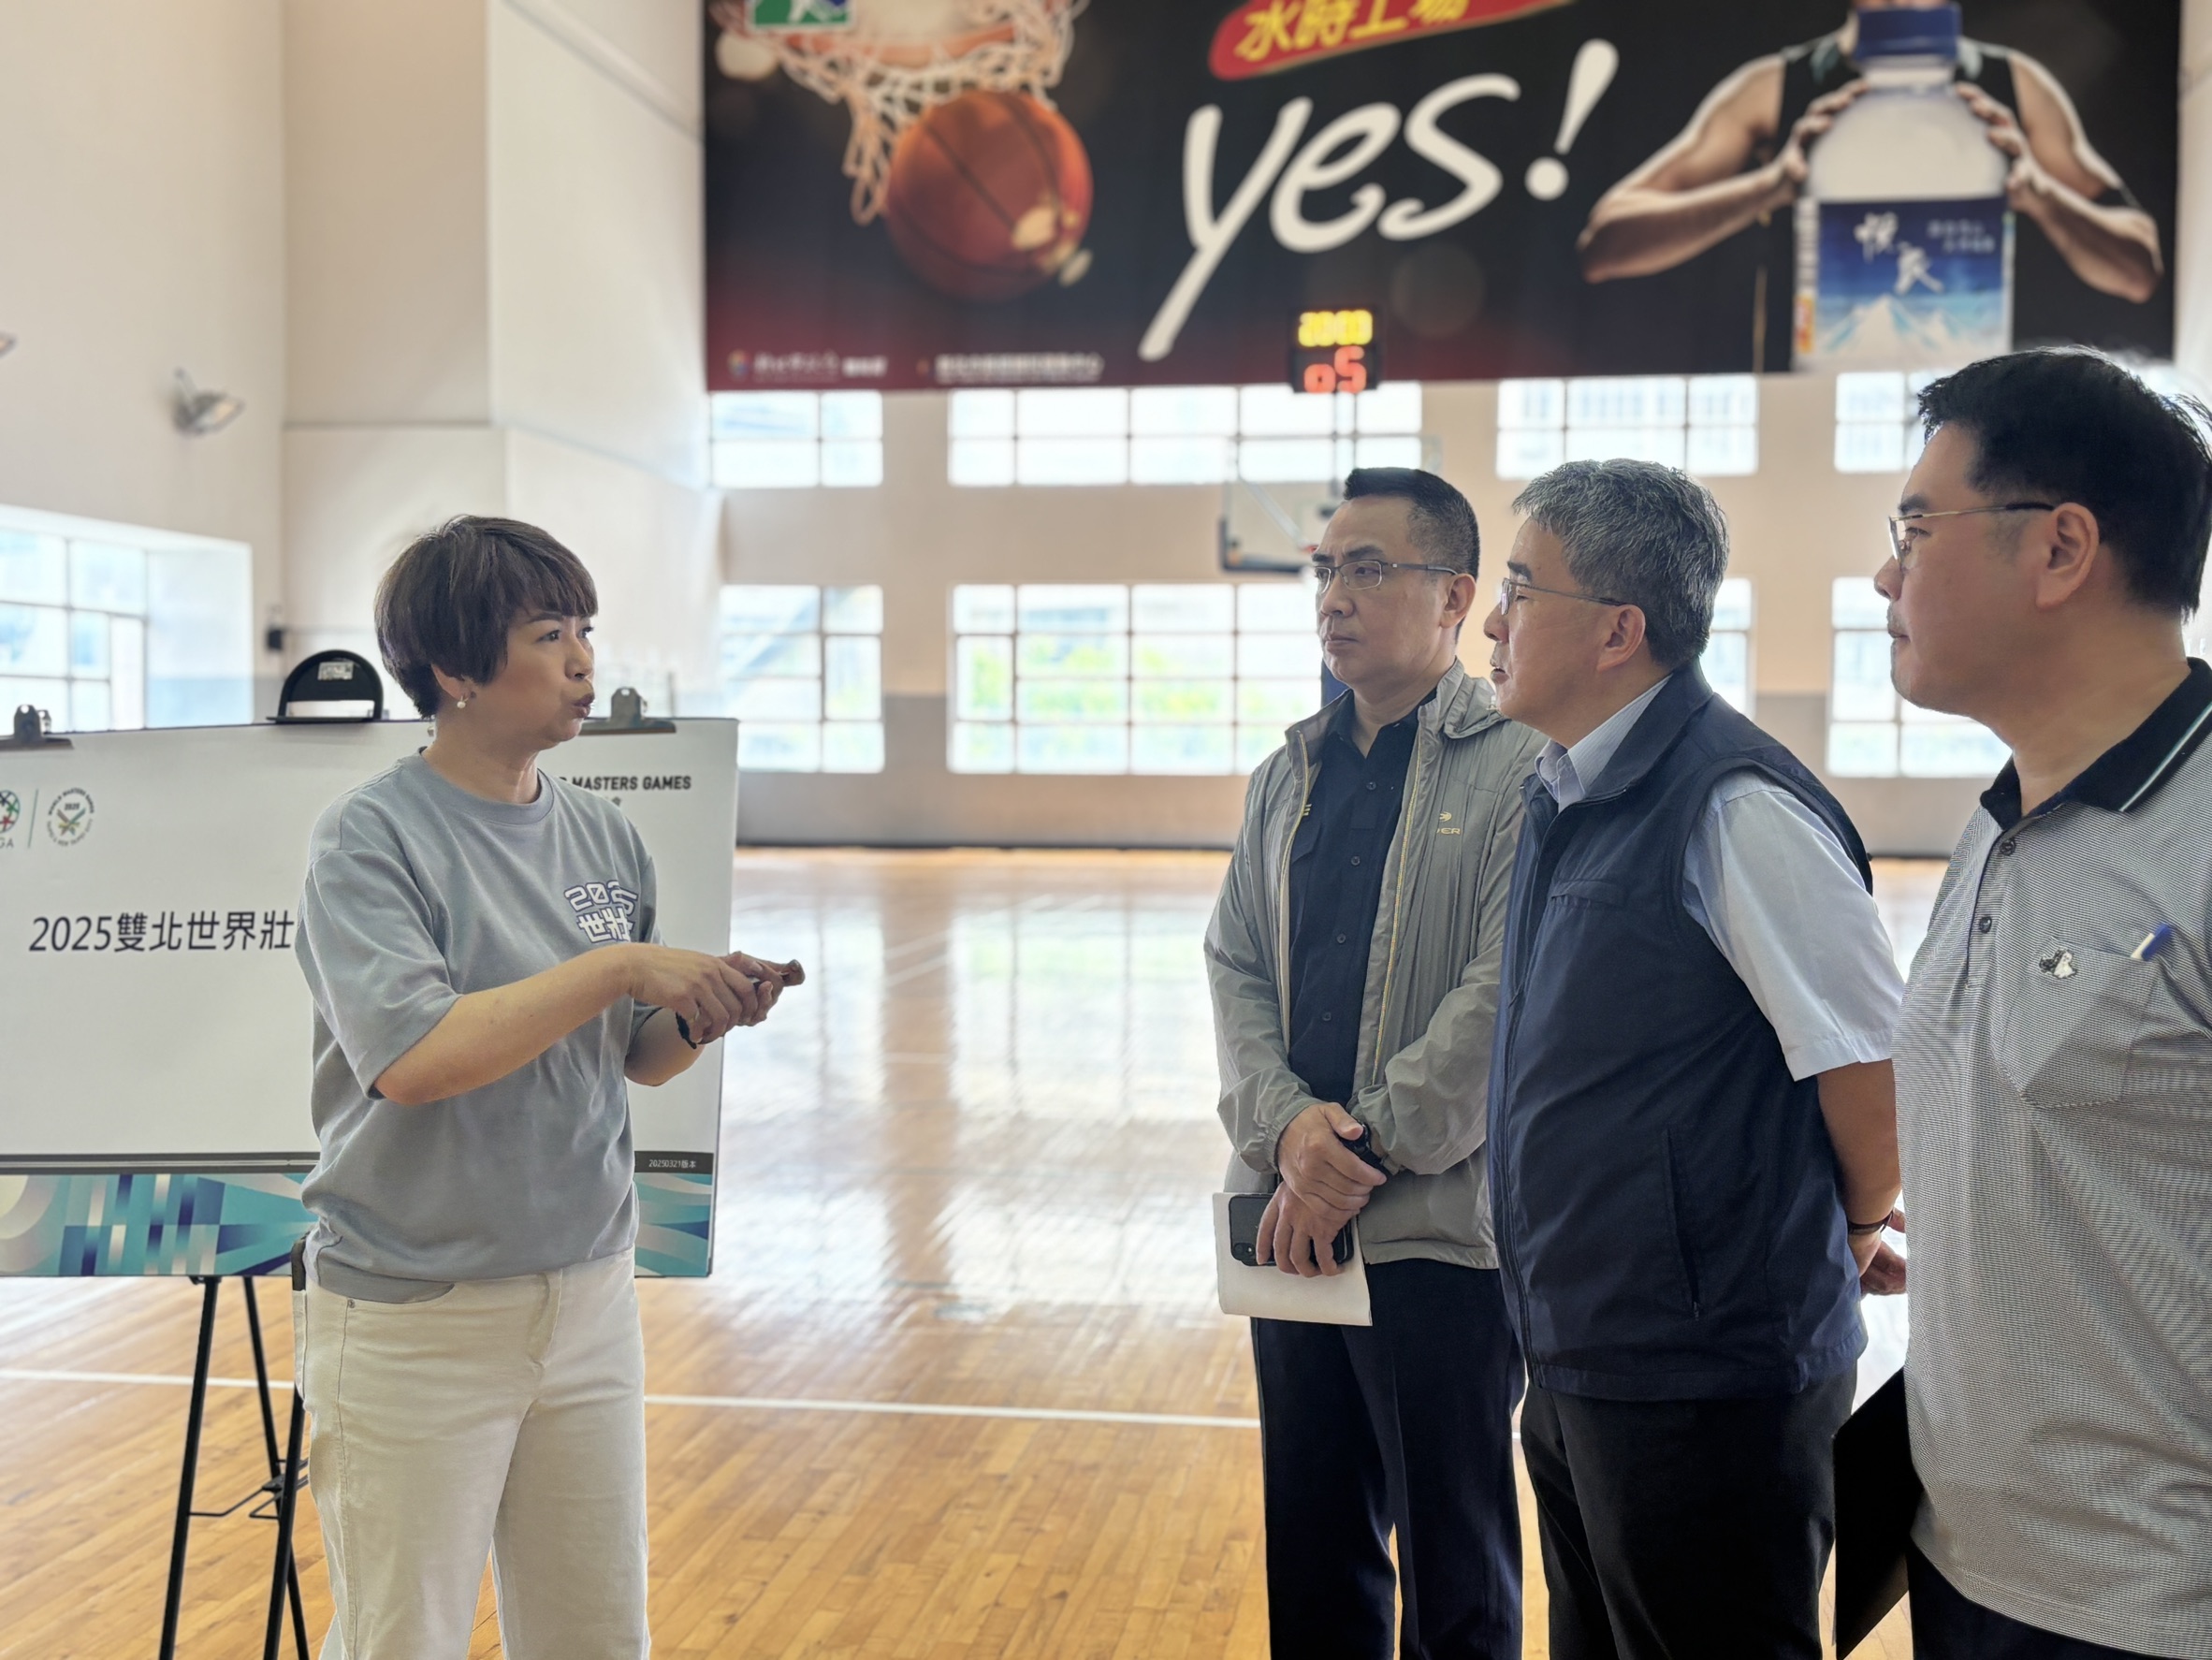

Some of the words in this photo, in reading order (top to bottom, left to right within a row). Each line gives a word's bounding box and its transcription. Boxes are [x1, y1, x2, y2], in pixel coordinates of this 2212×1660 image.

[572, 776, 638, 791] MASTERS
[642, 776, 691, 790] GAMES
[29, 910, 295, 953] 2025雙北世界壯
